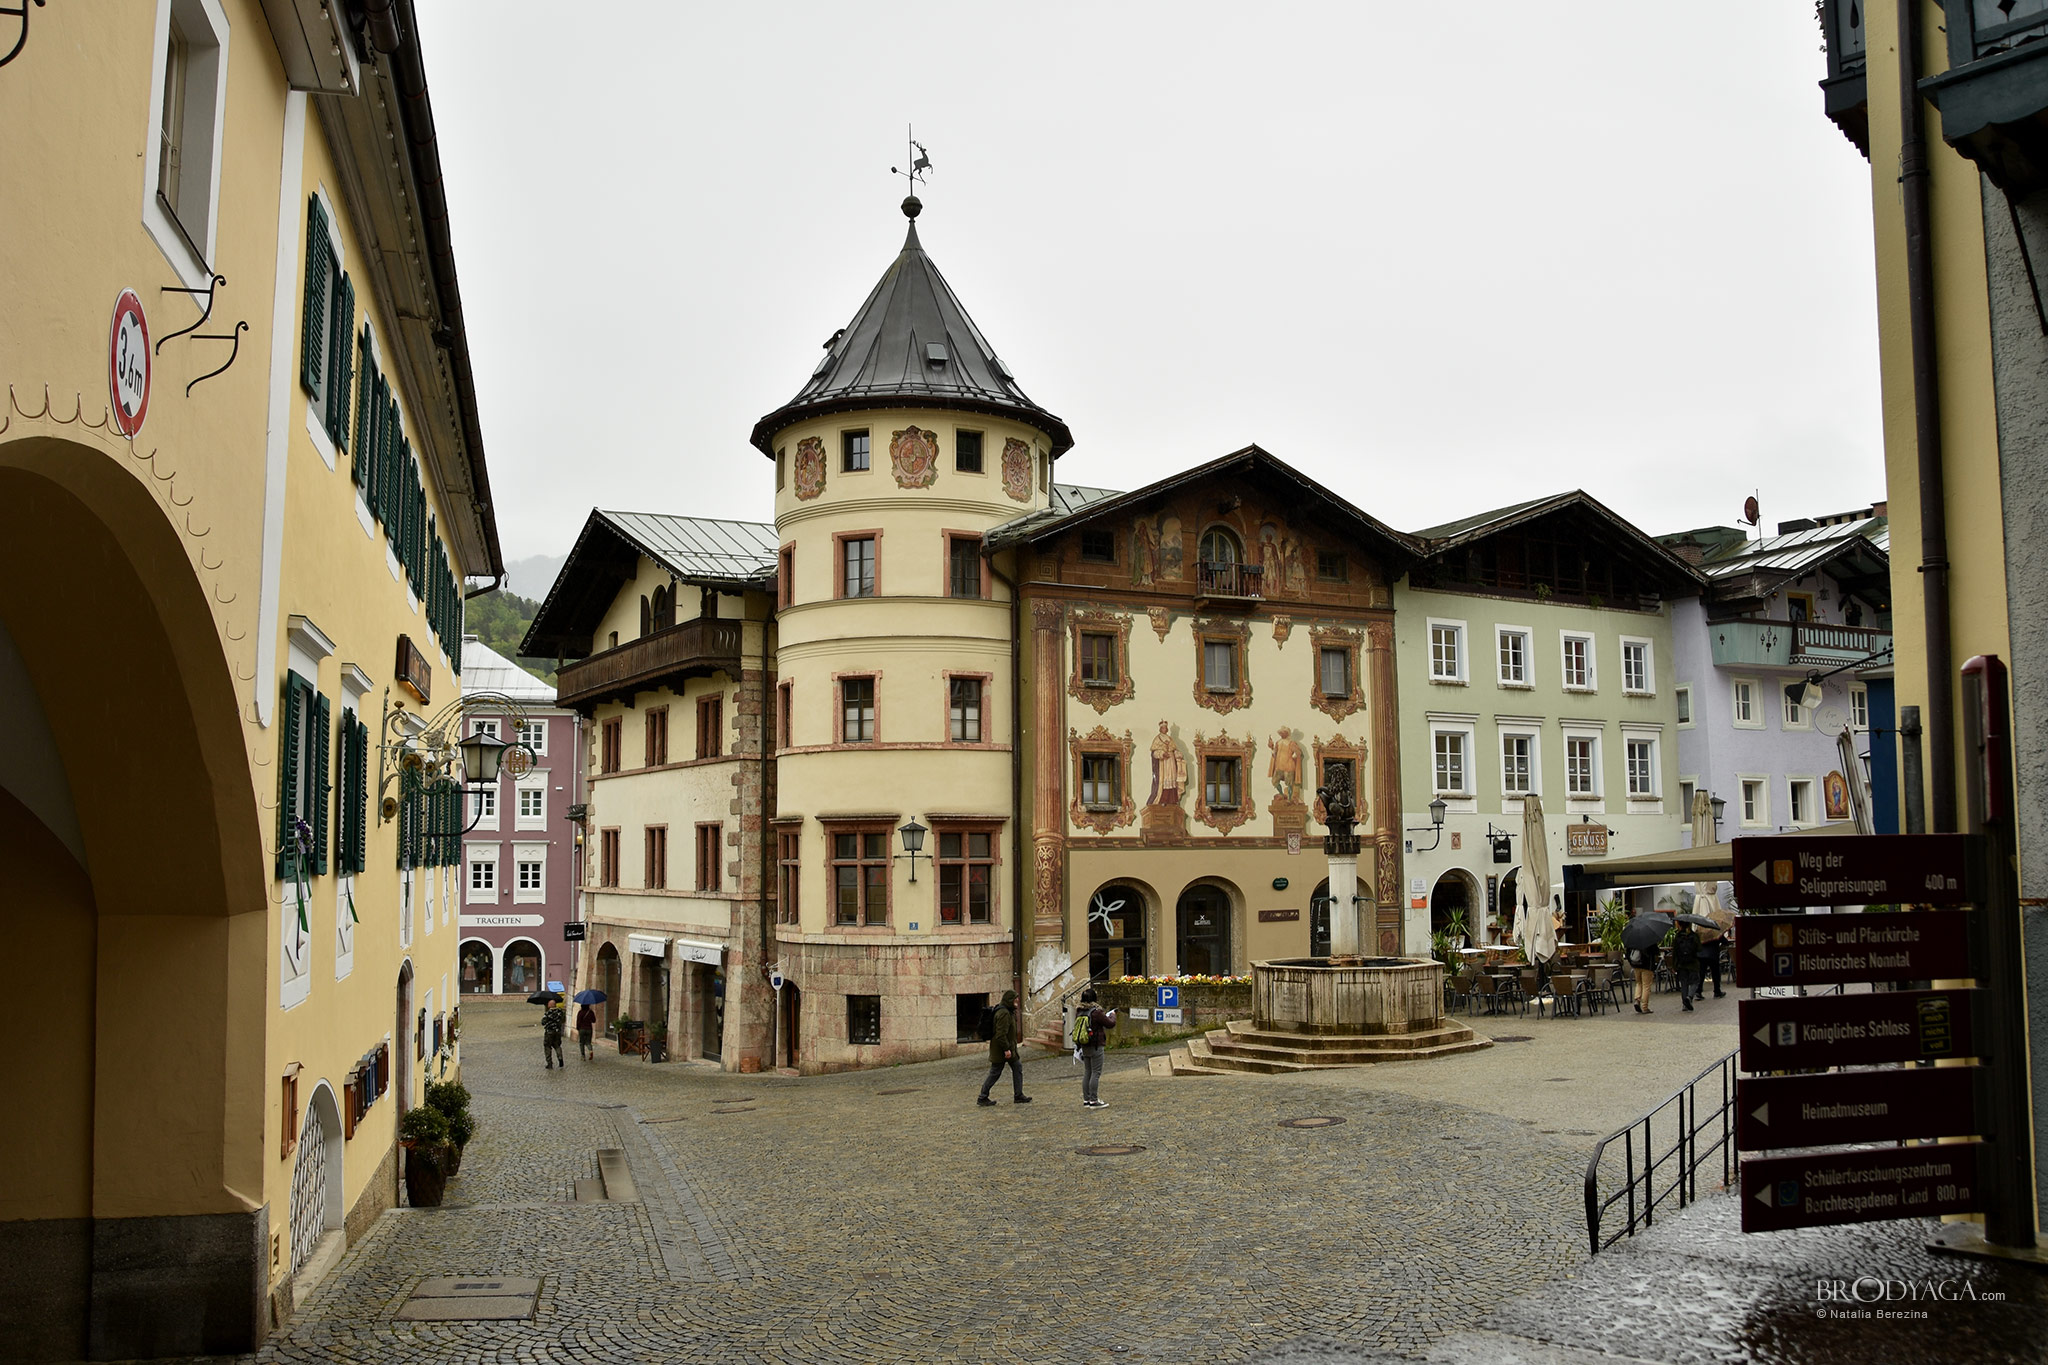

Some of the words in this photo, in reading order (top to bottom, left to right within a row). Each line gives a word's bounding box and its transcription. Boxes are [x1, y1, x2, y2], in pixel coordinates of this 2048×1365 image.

[1572, 834, 1605, 847] GENUSS
[1799, 851, 1822, 872] Weg
[1825, 850, 1844, 868] der
[1800, 876, 1887, 897] Seligpreisungen
[1925, 874, 1945, 891] 400
[1946, 878, 1957, 890] m
[475, 917, 522, 925] TRACHTEN
[1798, 928, 1833, 945] Stifts-
[1836, 927, 1857, 944] und
[1859, 926, 1920, 944] Pfarrkirche
[1778, 956, 1790, 974] P
[1799, 954, 1867, 972] Historisches
[1869, 951, 1911, 969] Nonntal
[1162, 989, 1174, 1005] P
[1768, 986, 1786, 997] ZONE
[1803, 1022, 1867, 1044] Königliches
[1868, 1019, 1911, 1037] Schloss
[1802, 1101, 1888, 1120] Heimatmuseum
[1804, 1163, 1951, 1188] Schülerforschungszentrum
[1805, 1191, 1898, 1214] Berchtesgadener
[1902, 1187, 1928, 1205] Land
[1937, 1184, 1956, 1202] 800
[1959, 1186, 1970, 1200] m
